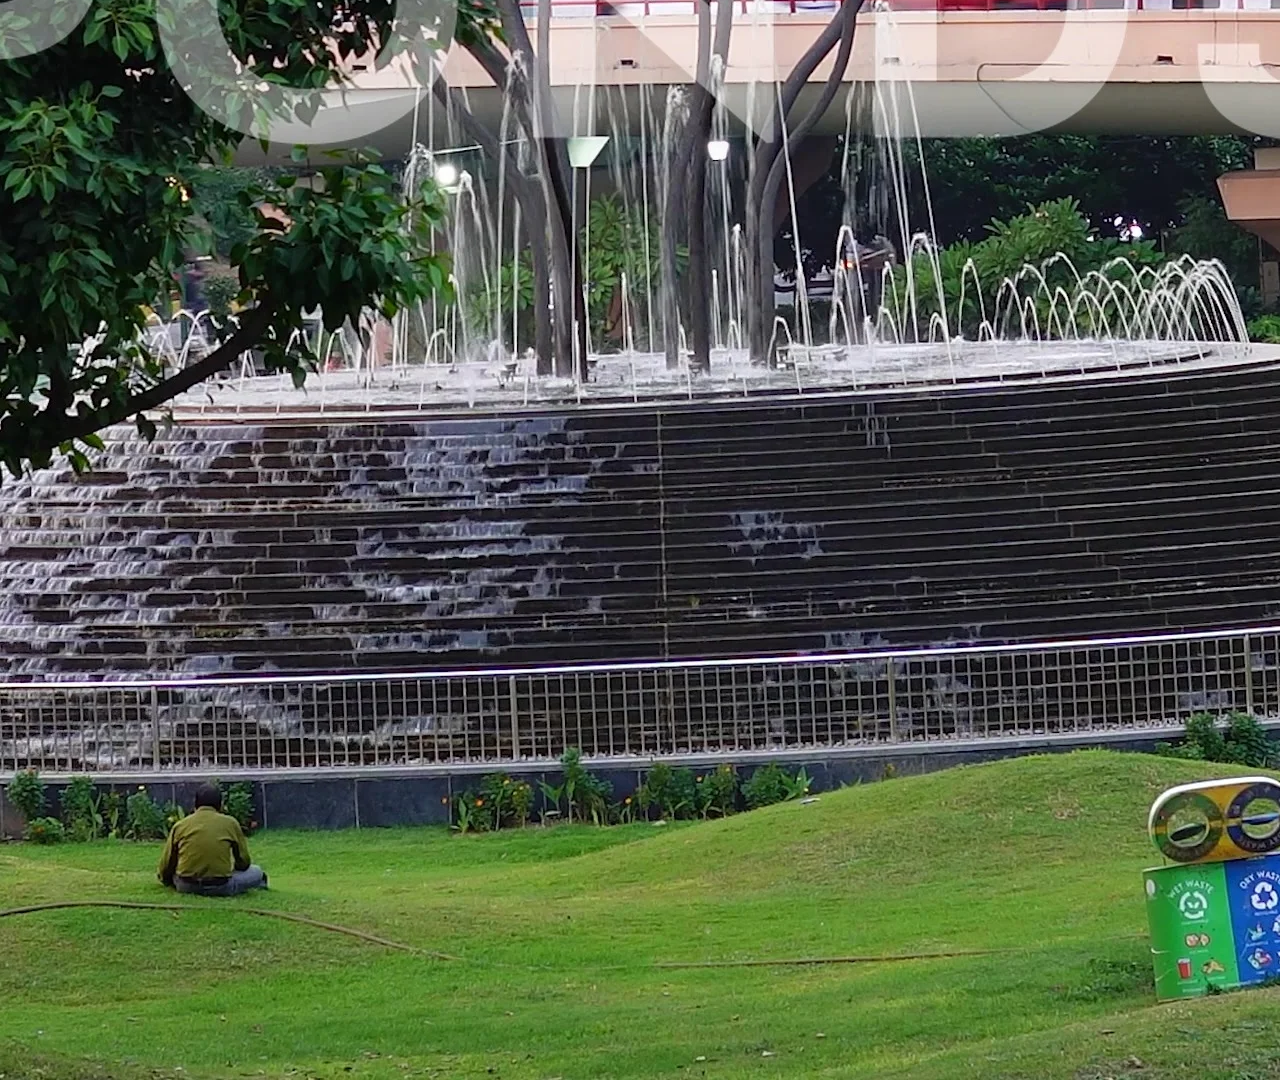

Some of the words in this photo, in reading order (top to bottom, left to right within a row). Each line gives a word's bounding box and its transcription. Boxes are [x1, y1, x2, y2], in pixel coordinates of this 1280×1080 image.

[1168, 882, 1183, 899] WET
[1185, 879, 1215, 895] WASTE
[1239, 873, 1255, 890] DRY
